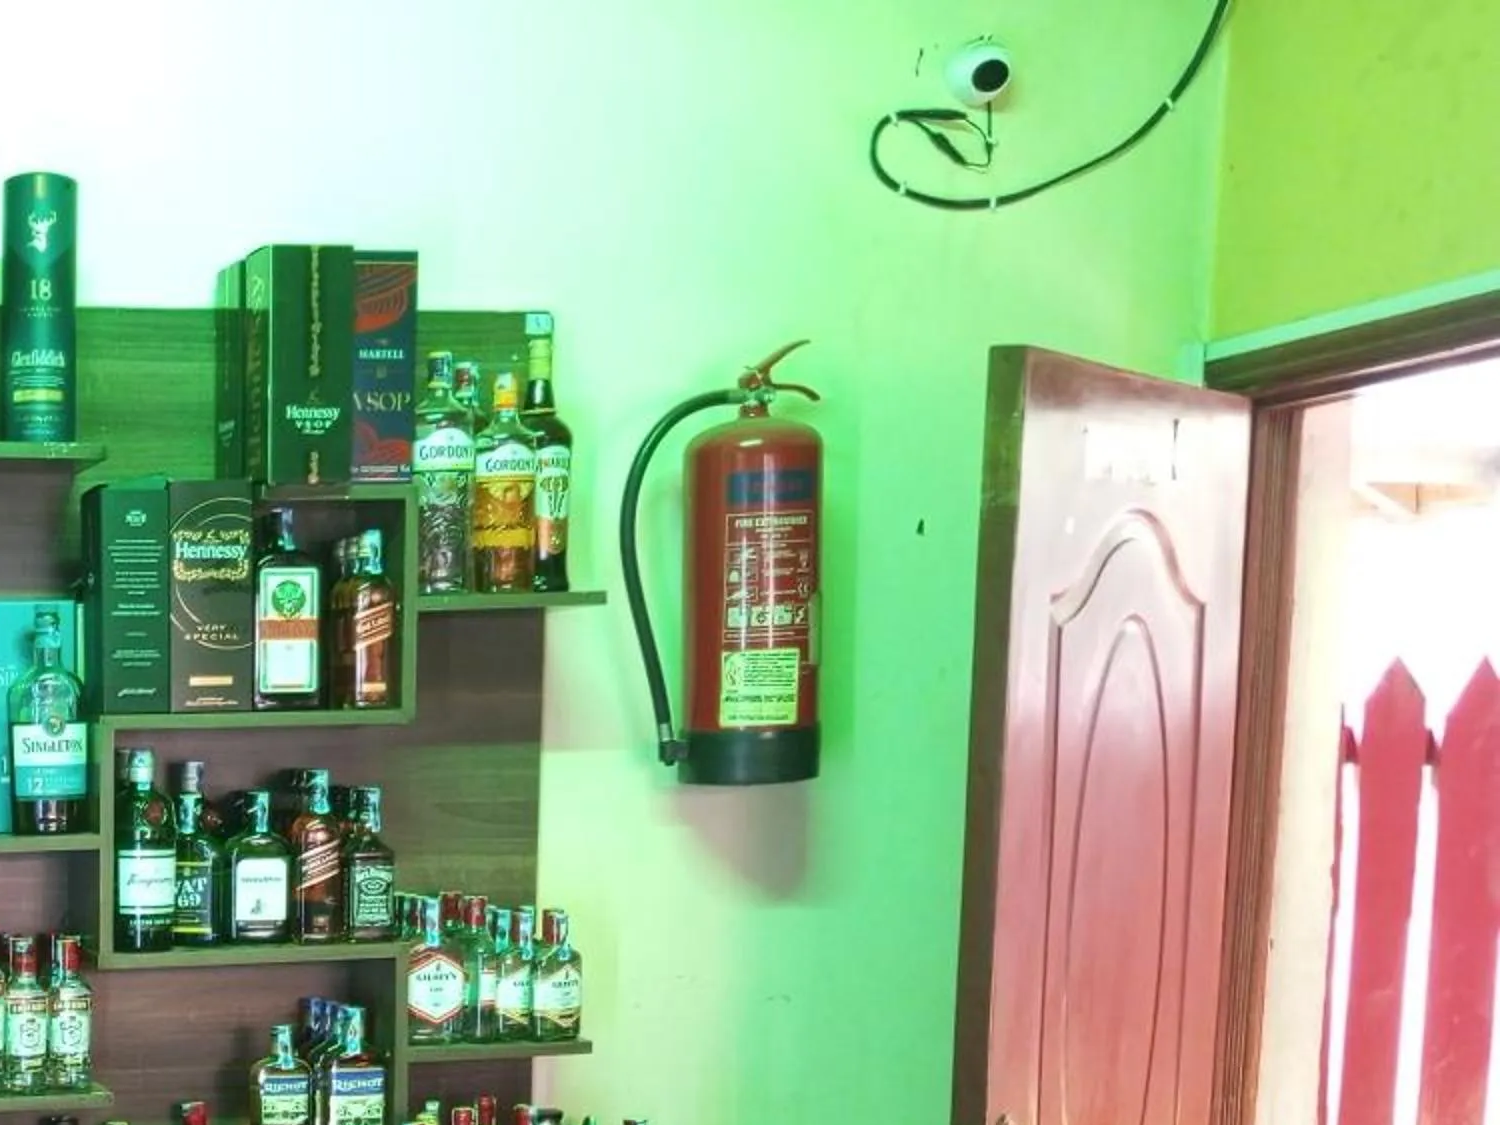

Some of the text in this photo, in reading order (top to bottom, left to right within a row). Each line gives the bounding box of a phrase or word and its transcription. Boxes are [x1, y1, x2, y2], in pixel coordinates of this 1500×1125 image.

[30, 279, 53, 302] 18
[359, 349, 405, 360] MARTELL
[353, 391, 410, 413] VSOP
[286, 405, 341, 423] Hennessy
[175, 542, 248, 561] Hennessy
[21, 737, 84, 755] SINGLETON
[175, 877, 207, 895] AT
